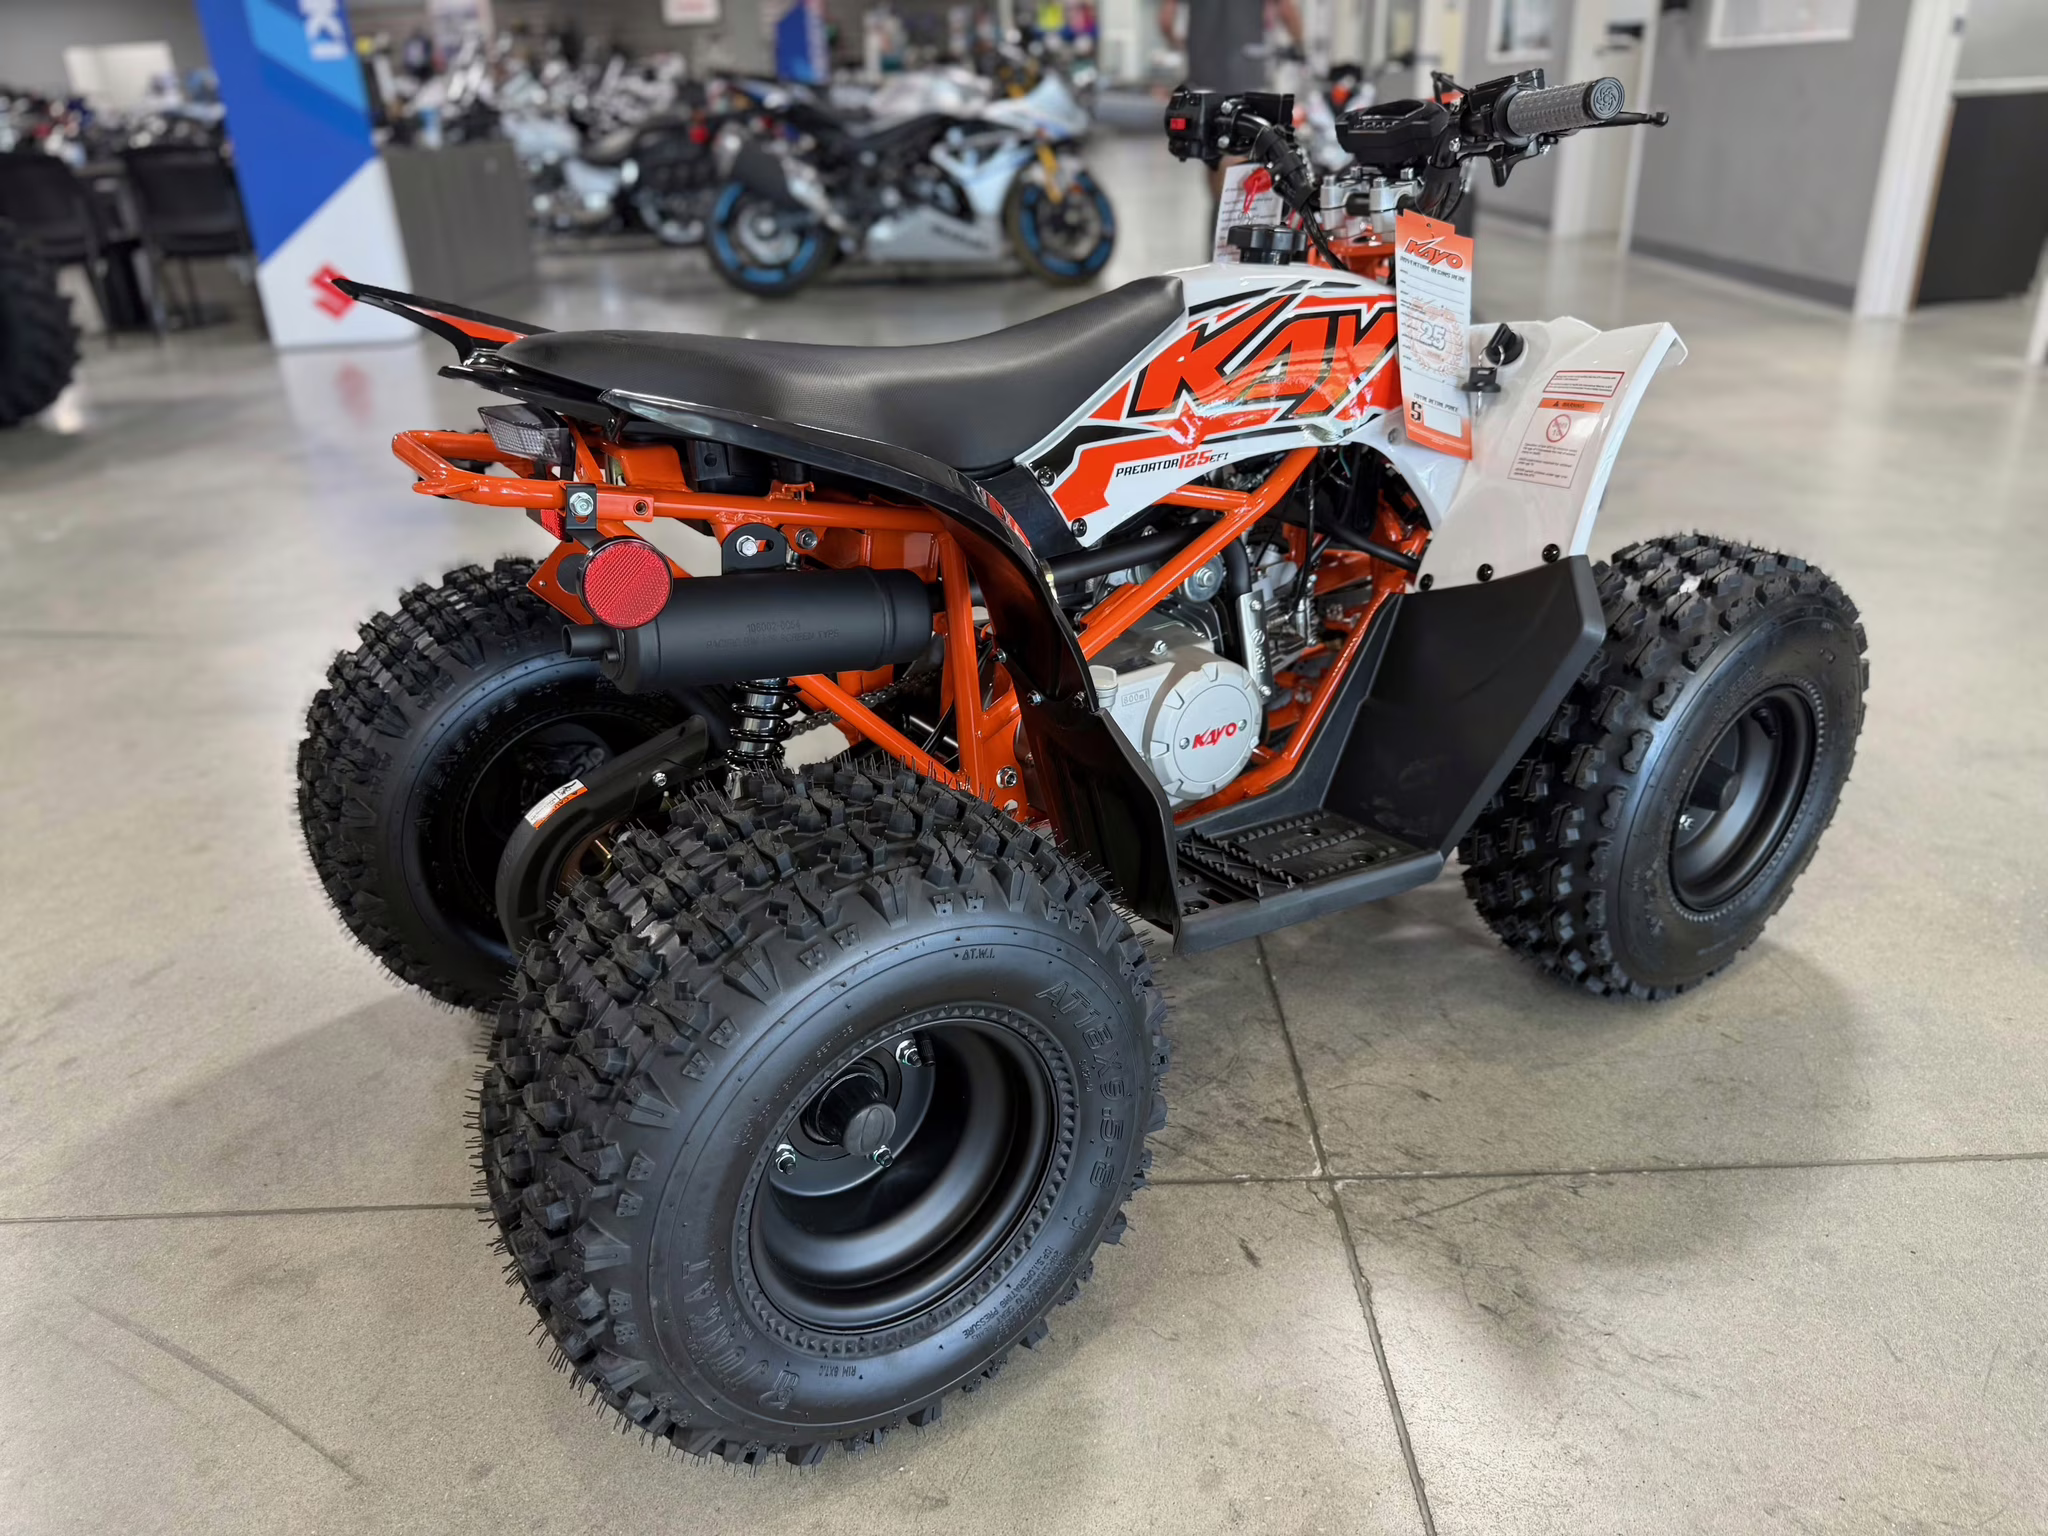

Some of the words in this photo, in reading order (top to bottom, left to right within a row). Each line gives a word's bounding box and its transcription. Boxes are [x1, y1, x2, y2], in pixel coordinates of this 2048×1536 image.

[1404, 236, 1463, 269] KAYO
[1400, 256, 1430, 272] ADVENTURE
[1451, 274, 1465, 282] HERE
[1420, 321, 1446, 352] 25
[1126, 292, 1397, 423] KAY
[1411, 400, 1422, 421] $
[1115, 458, 1179, 477] PREDATOR
[1178, 450, 1213, 469] 125
[1122, 689, 1149, 705] 800ml
[1192, 722, 1238, 749] KAYO
[1035, 980, 1125, 1187] AT18X9.5-8
[962, 1307, 999, 1339] PRESSURE
